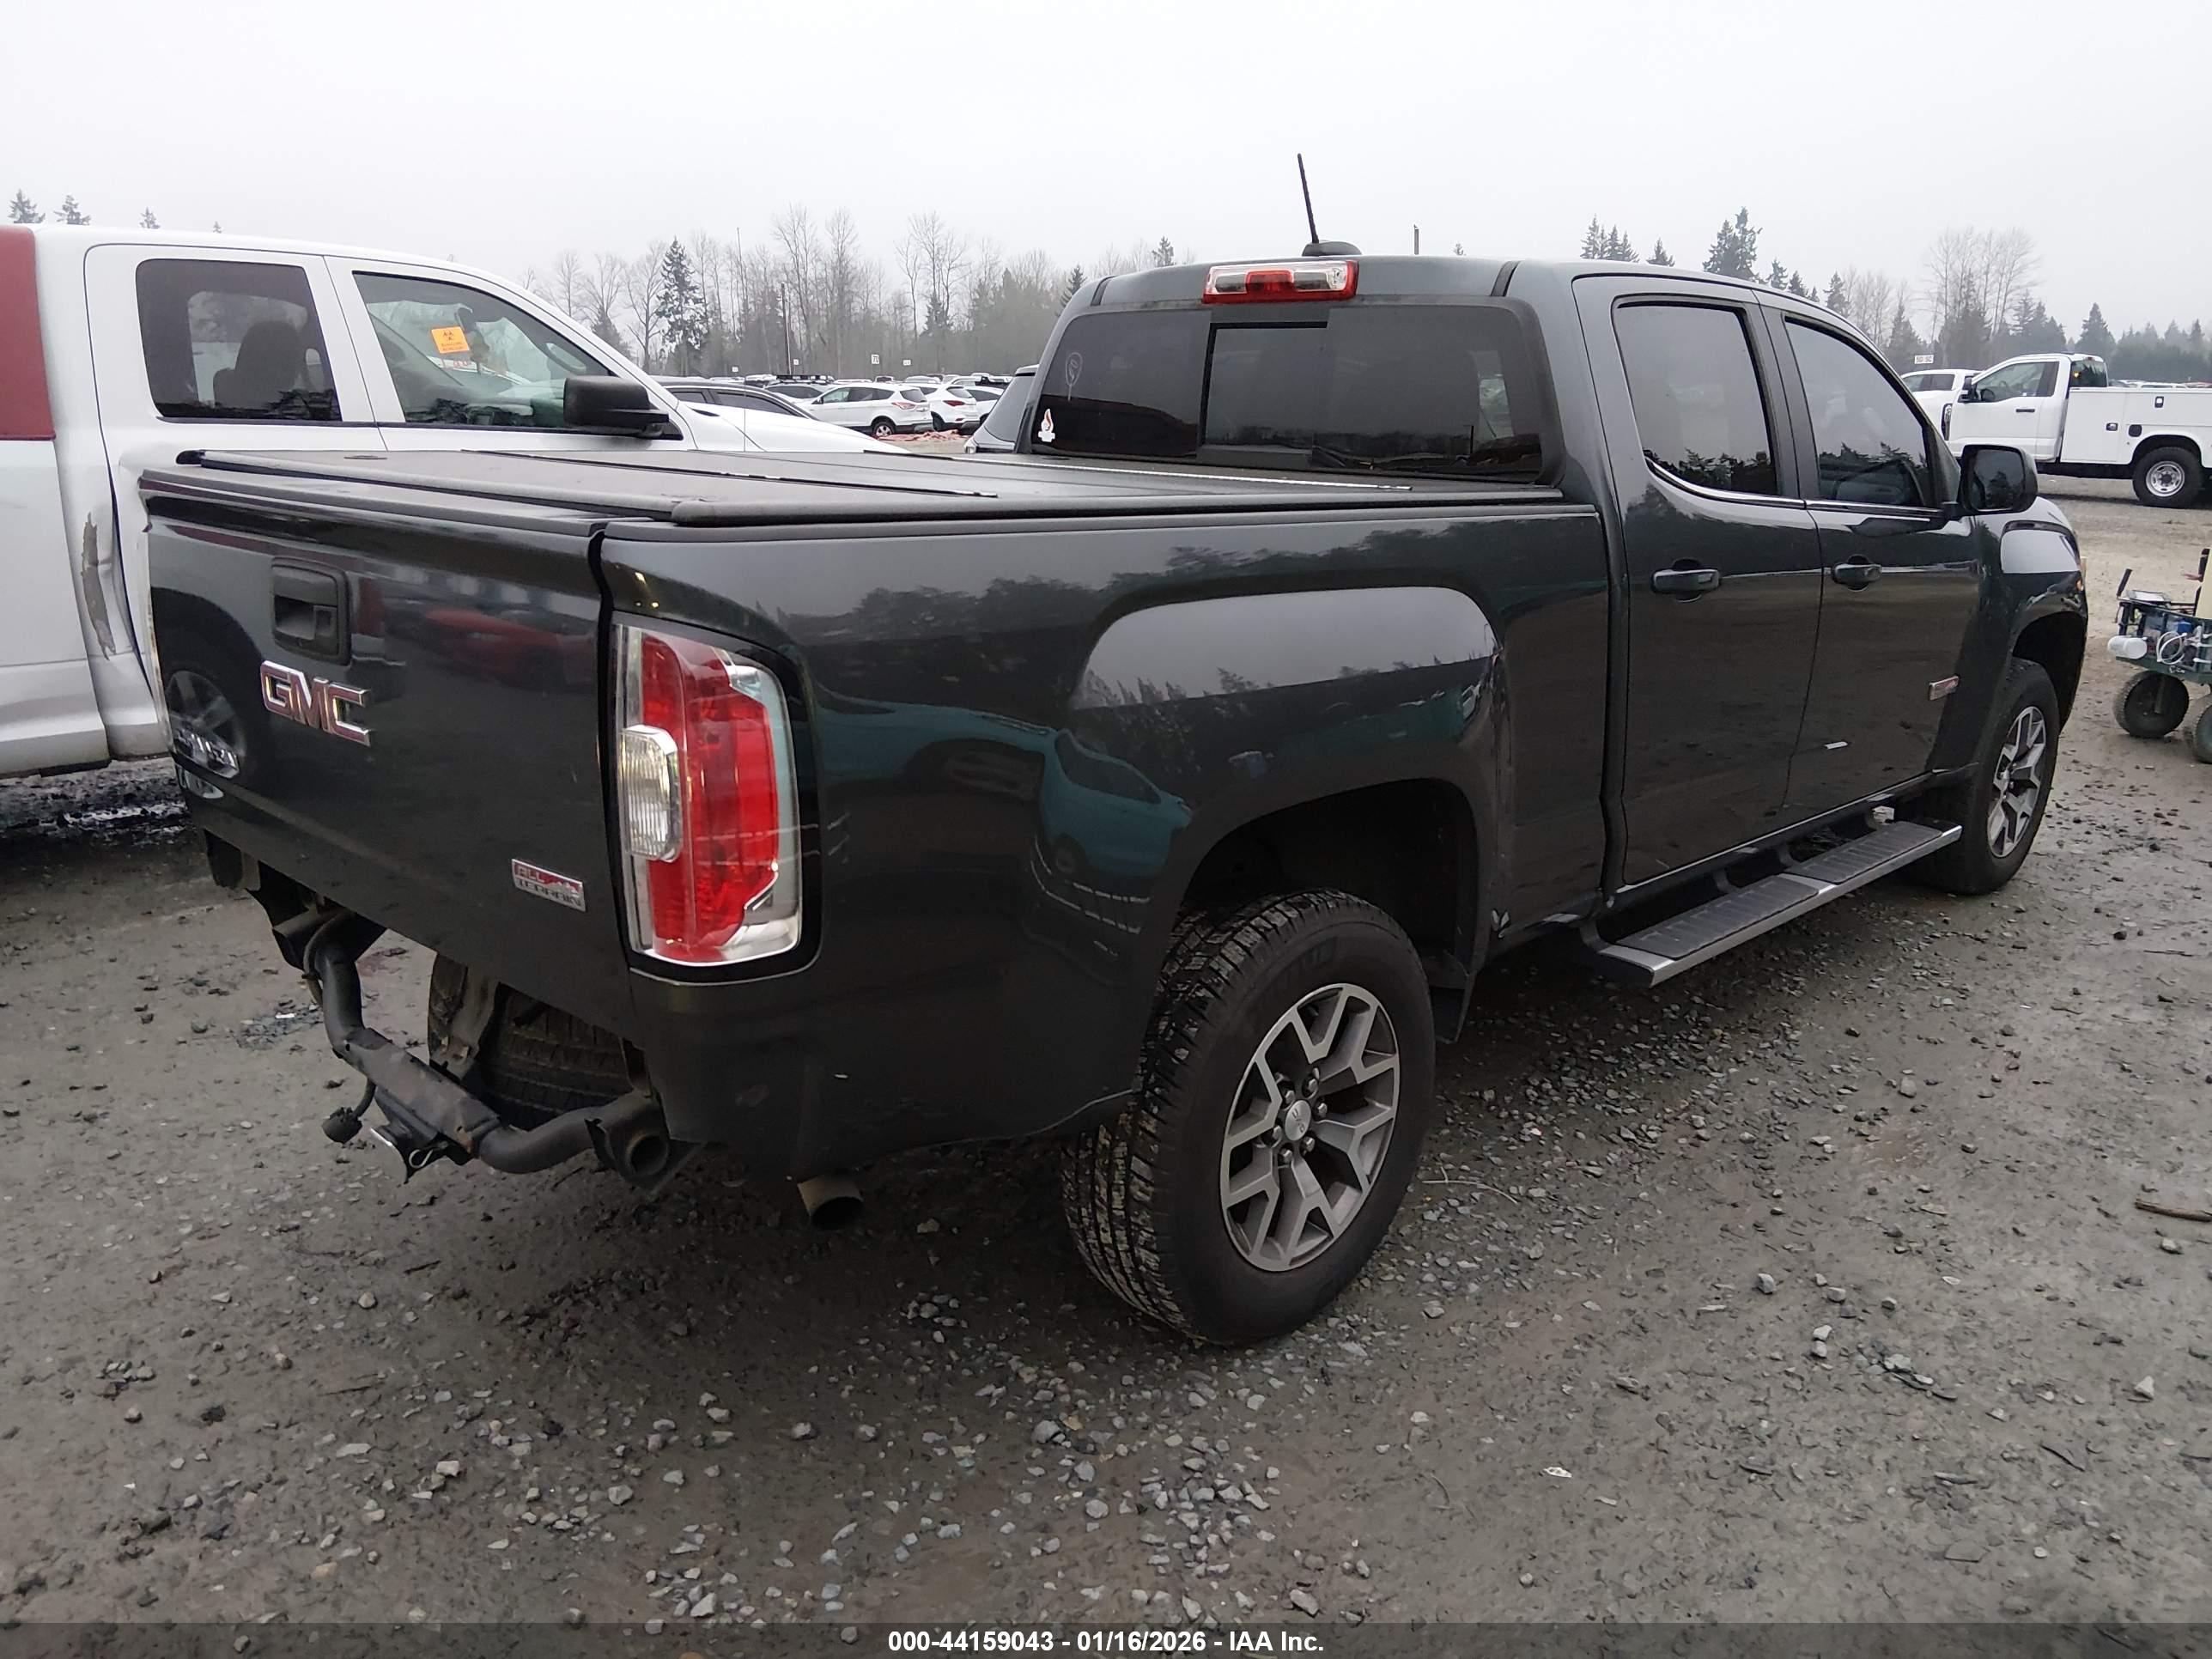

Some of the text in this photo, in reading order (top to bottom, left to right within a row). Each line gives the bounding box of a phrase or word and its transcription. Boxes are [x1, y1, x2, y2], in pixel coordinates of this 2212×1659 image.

[260, 660, 371, 747] GMC
[517, 865, 545, 883] ALL
[517, 878, 582, 907] TERRAIN
